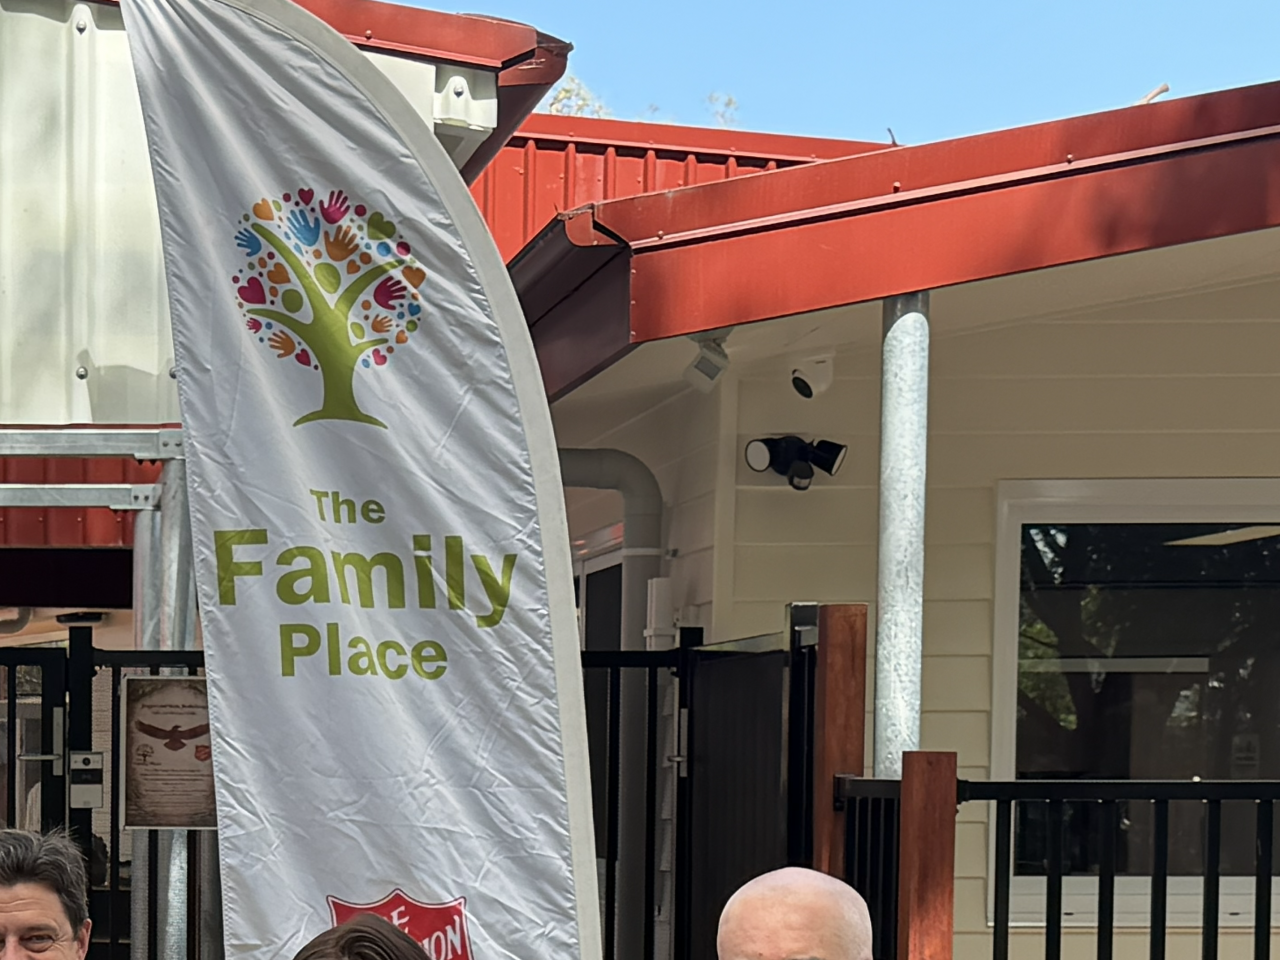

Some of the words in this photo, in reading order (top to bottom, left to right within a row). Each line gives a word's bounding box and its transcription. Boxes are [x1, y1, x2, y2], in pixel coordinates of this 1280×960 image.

[310, 489, 386, 524] The
[213, 528, 518, 628] Family
[280, 622, 448, 680] Place
